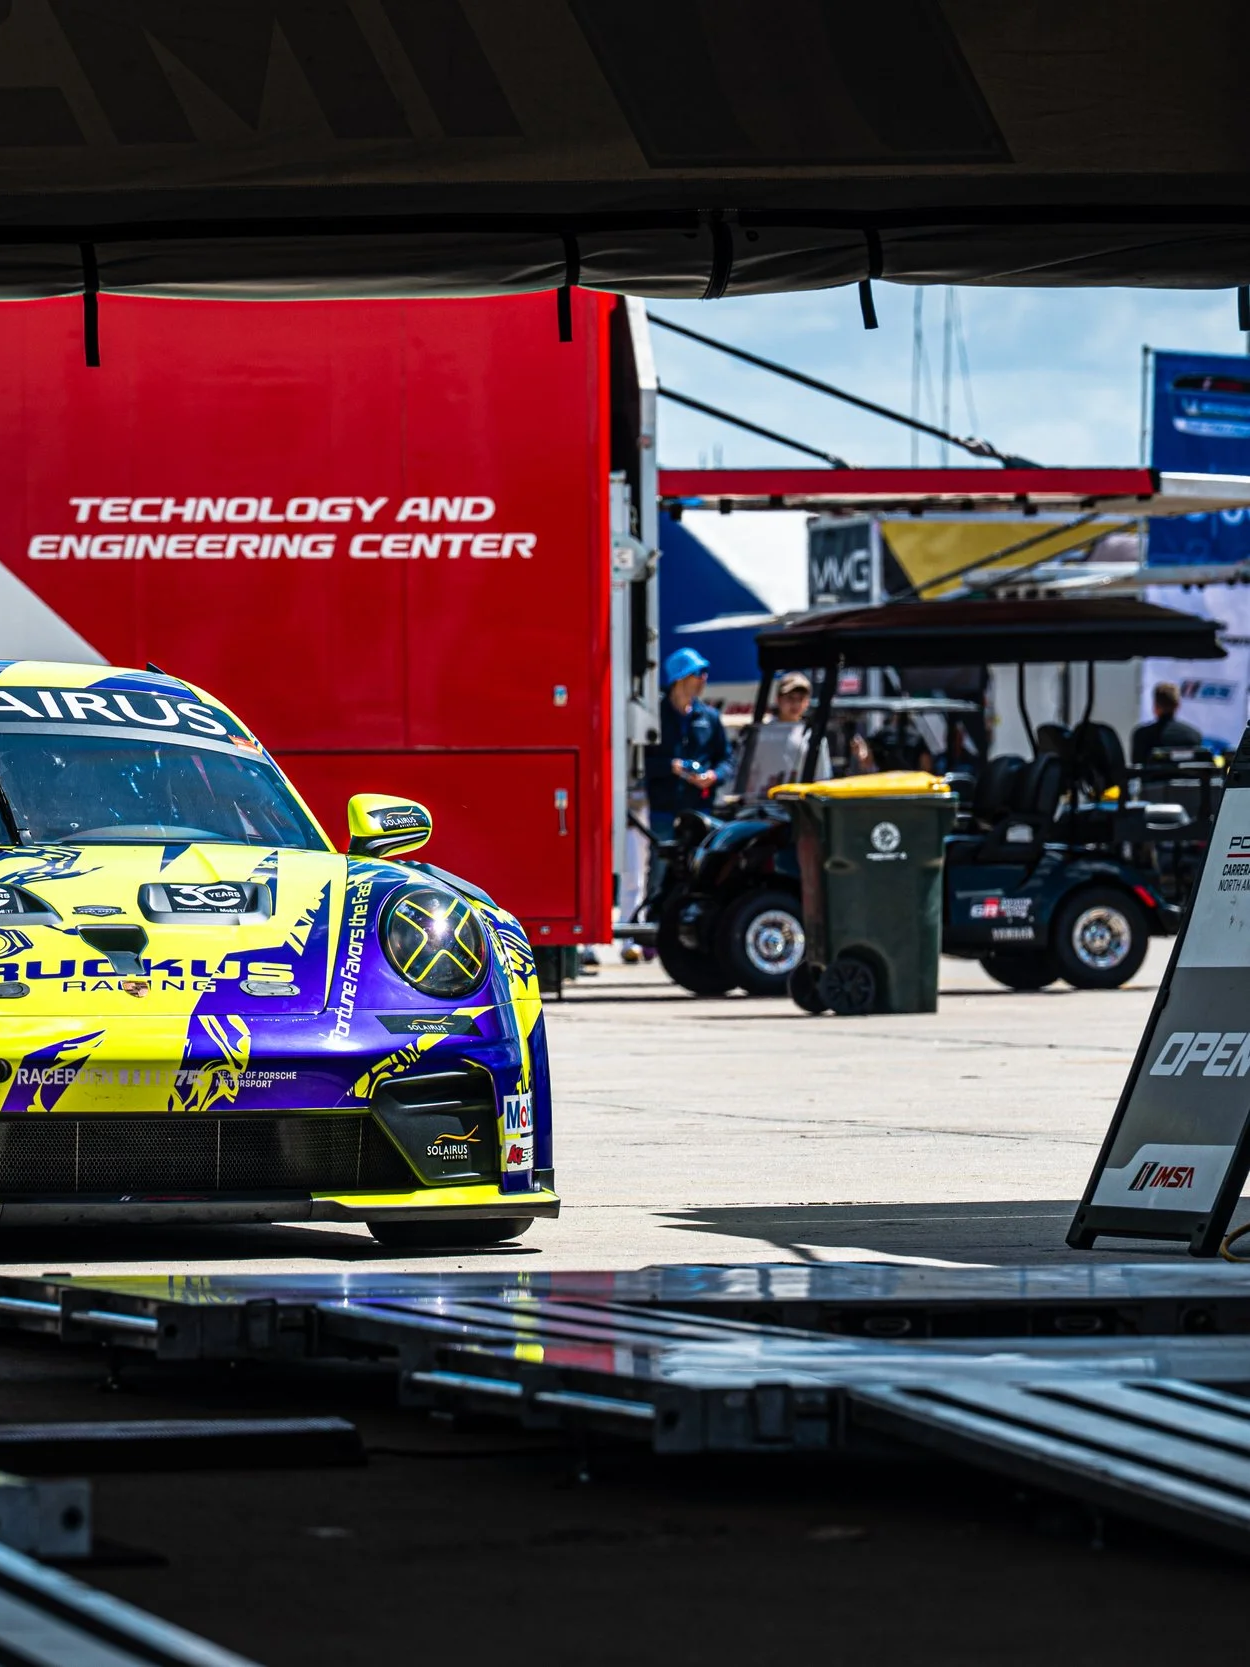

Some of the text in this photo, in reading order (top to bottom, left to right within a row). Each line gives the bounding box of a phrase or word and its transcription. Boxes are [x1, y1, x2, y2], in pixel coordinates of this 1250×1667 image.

[69, 496, 496, 524] TECHNOLOGY AND
[27, 532, 538, 560] ENGINEERING CENTER
[1218, 879, 1241, 891] NORTH
[348, 903, 368, 927] the
[340, 928, 365, 982] Favors
[62, 980, 217, 993] RAING
[215, 1079, 273, 1088] MOTORSPORT
[245, 1071, 257, 1079] OF
[258, 1071, 297, 1080] PORSCHE
[426, 1144, 468, 1156] SOLAIRUS
[1150, 1166, 1195, 1189] IMSA
